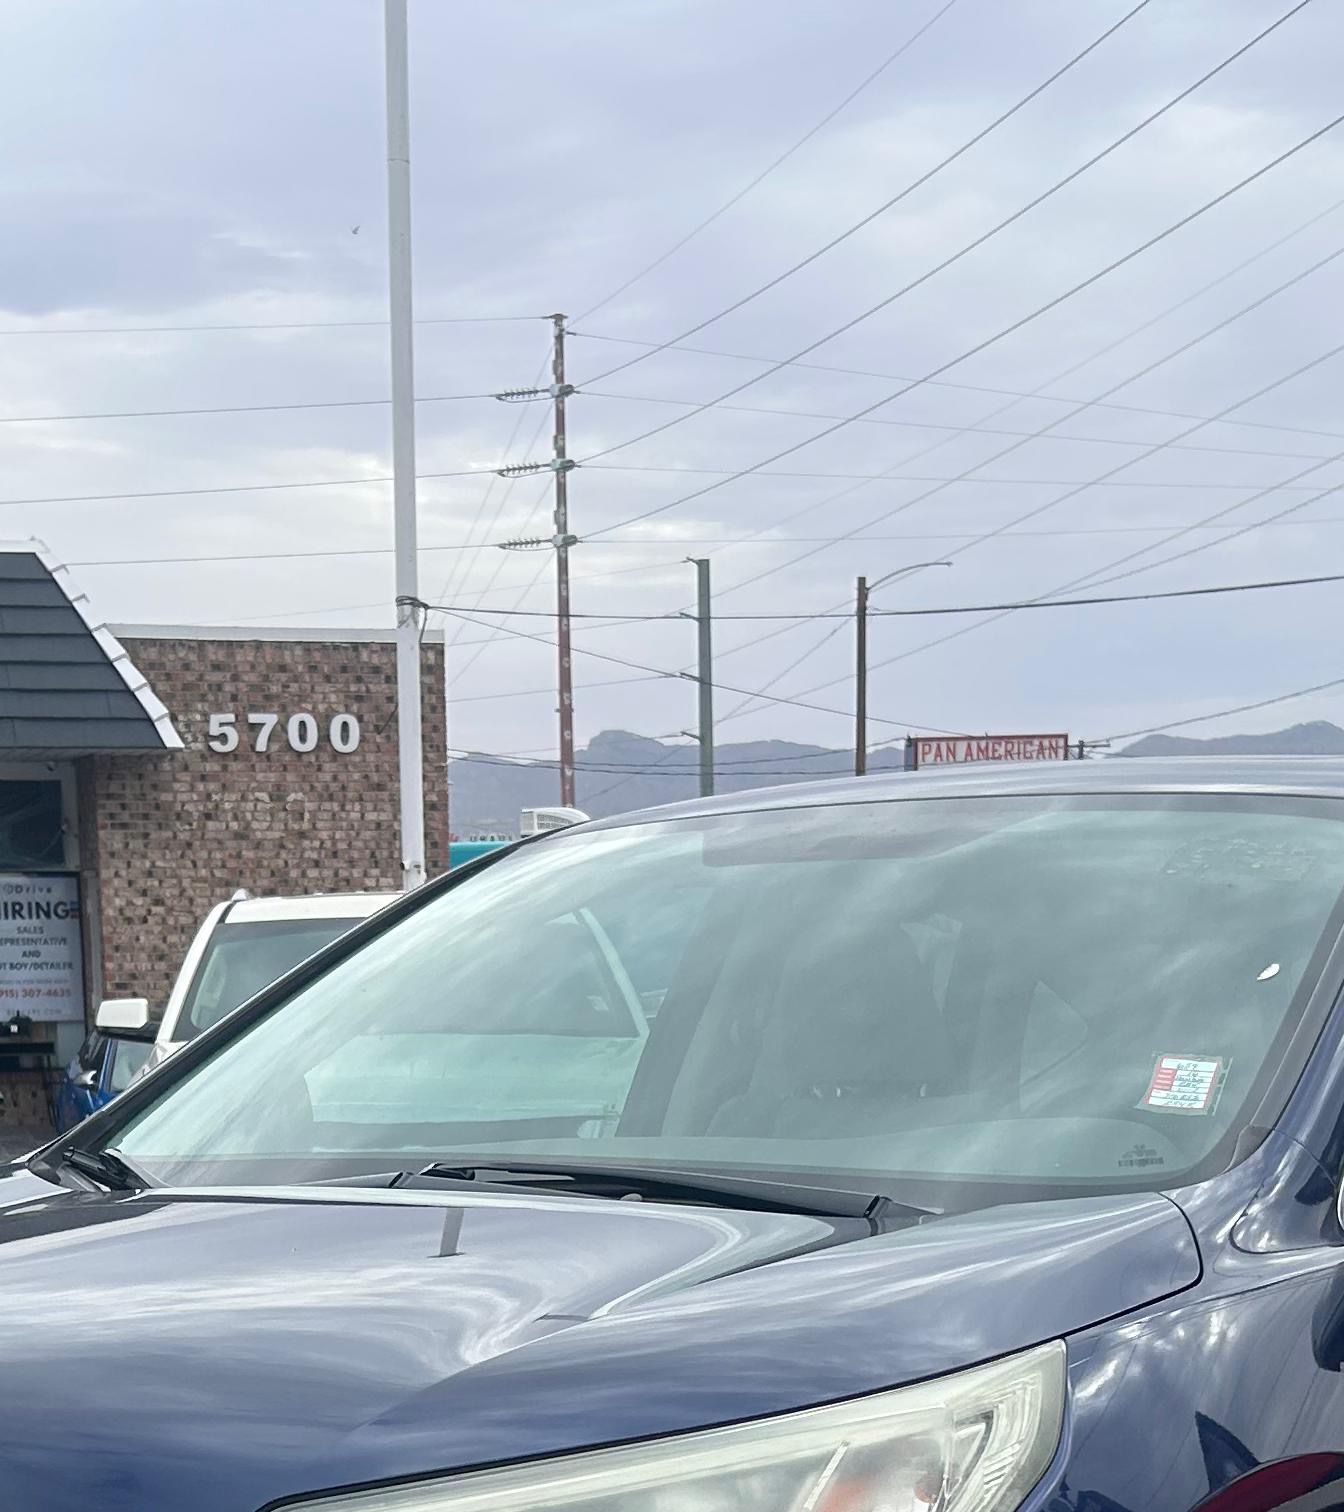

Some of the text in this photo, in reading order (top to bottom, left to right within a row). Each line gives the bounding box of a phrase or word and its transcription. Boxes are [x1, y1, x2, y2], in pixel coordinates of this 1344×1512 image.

[208, 712, 360, 753] 5700
[921, 738, 1059, 763] PAN AMERICAN
[16, 926, 44, 935] SALES
[21, 950, 41, 958] AND
